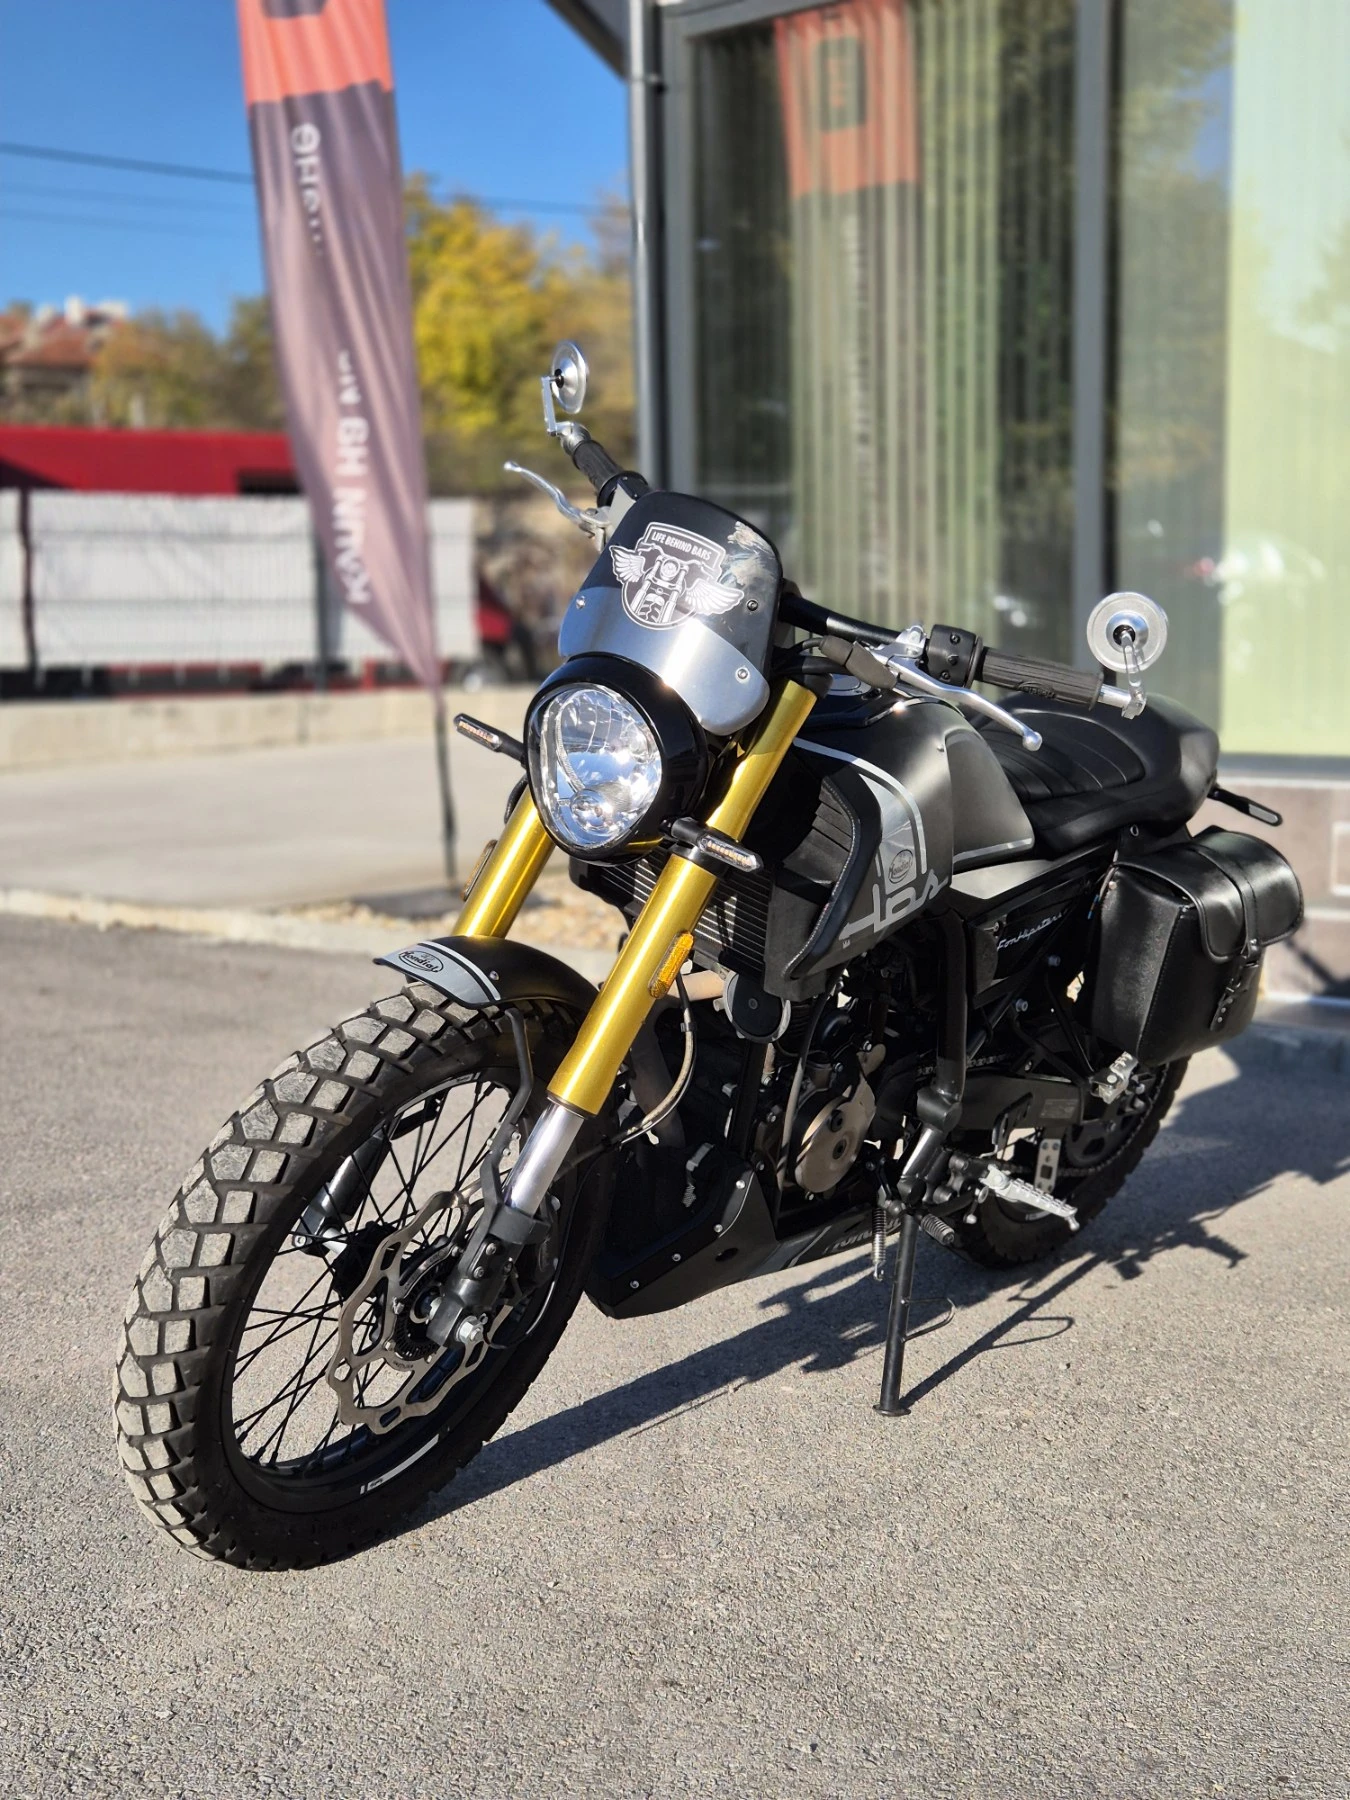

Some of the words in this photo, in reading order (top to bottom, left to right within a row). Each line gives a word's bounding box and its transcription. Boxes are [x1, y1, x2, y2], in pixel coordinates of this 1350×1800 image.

[652, 531, 666, 543] LIFE
[665, 536, 692, 552] BEHIND
[691, 545, 711, 560] BARS
